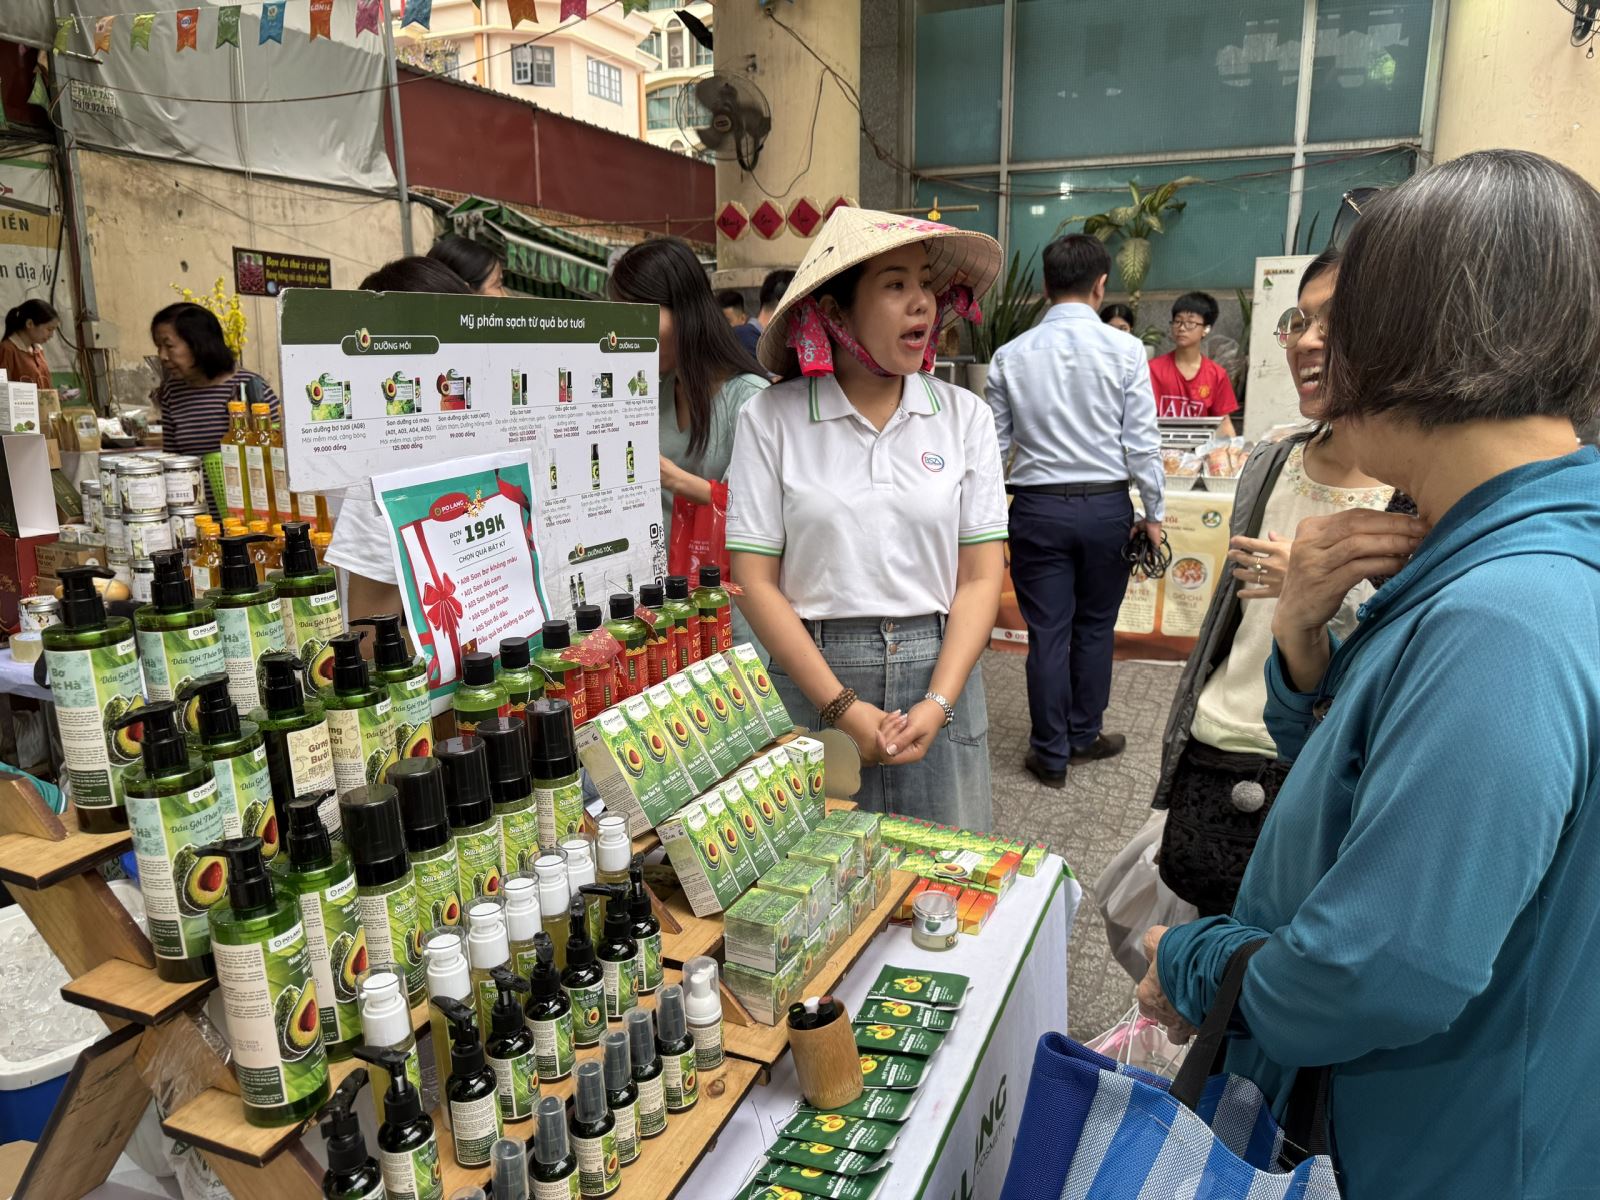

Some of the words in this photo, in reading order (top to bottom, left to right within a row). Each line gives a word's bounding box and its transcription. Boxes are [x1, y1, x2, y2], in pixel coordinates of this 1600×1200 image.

[15, 262, 36, 282] địa
[43, 265, 52, 286] lý
[460, 314, 474, 331] Mỹ
[478, 313, 503, 330] phẩm
[506, 315, 527, 329] sạch
[529, 316, 539, 328] từ
[541, 317, 556, 330] quả
[558, 317, 568, 328] bơ
[570, 318, 586, 328] tươi
[374, 341, 397, 351] DƯỠNG
[398, 341, 412, 351] MÔI
[314, 445, 331, 453] 99.000
[449, 530, 462, 539] ĐƠN
[465, 513, 506, 543] 199K
[65, 680, 82, 690] Hà
[308, 739, 329, 754] Gừng
[310, 750, 330, 765] Bưởi
